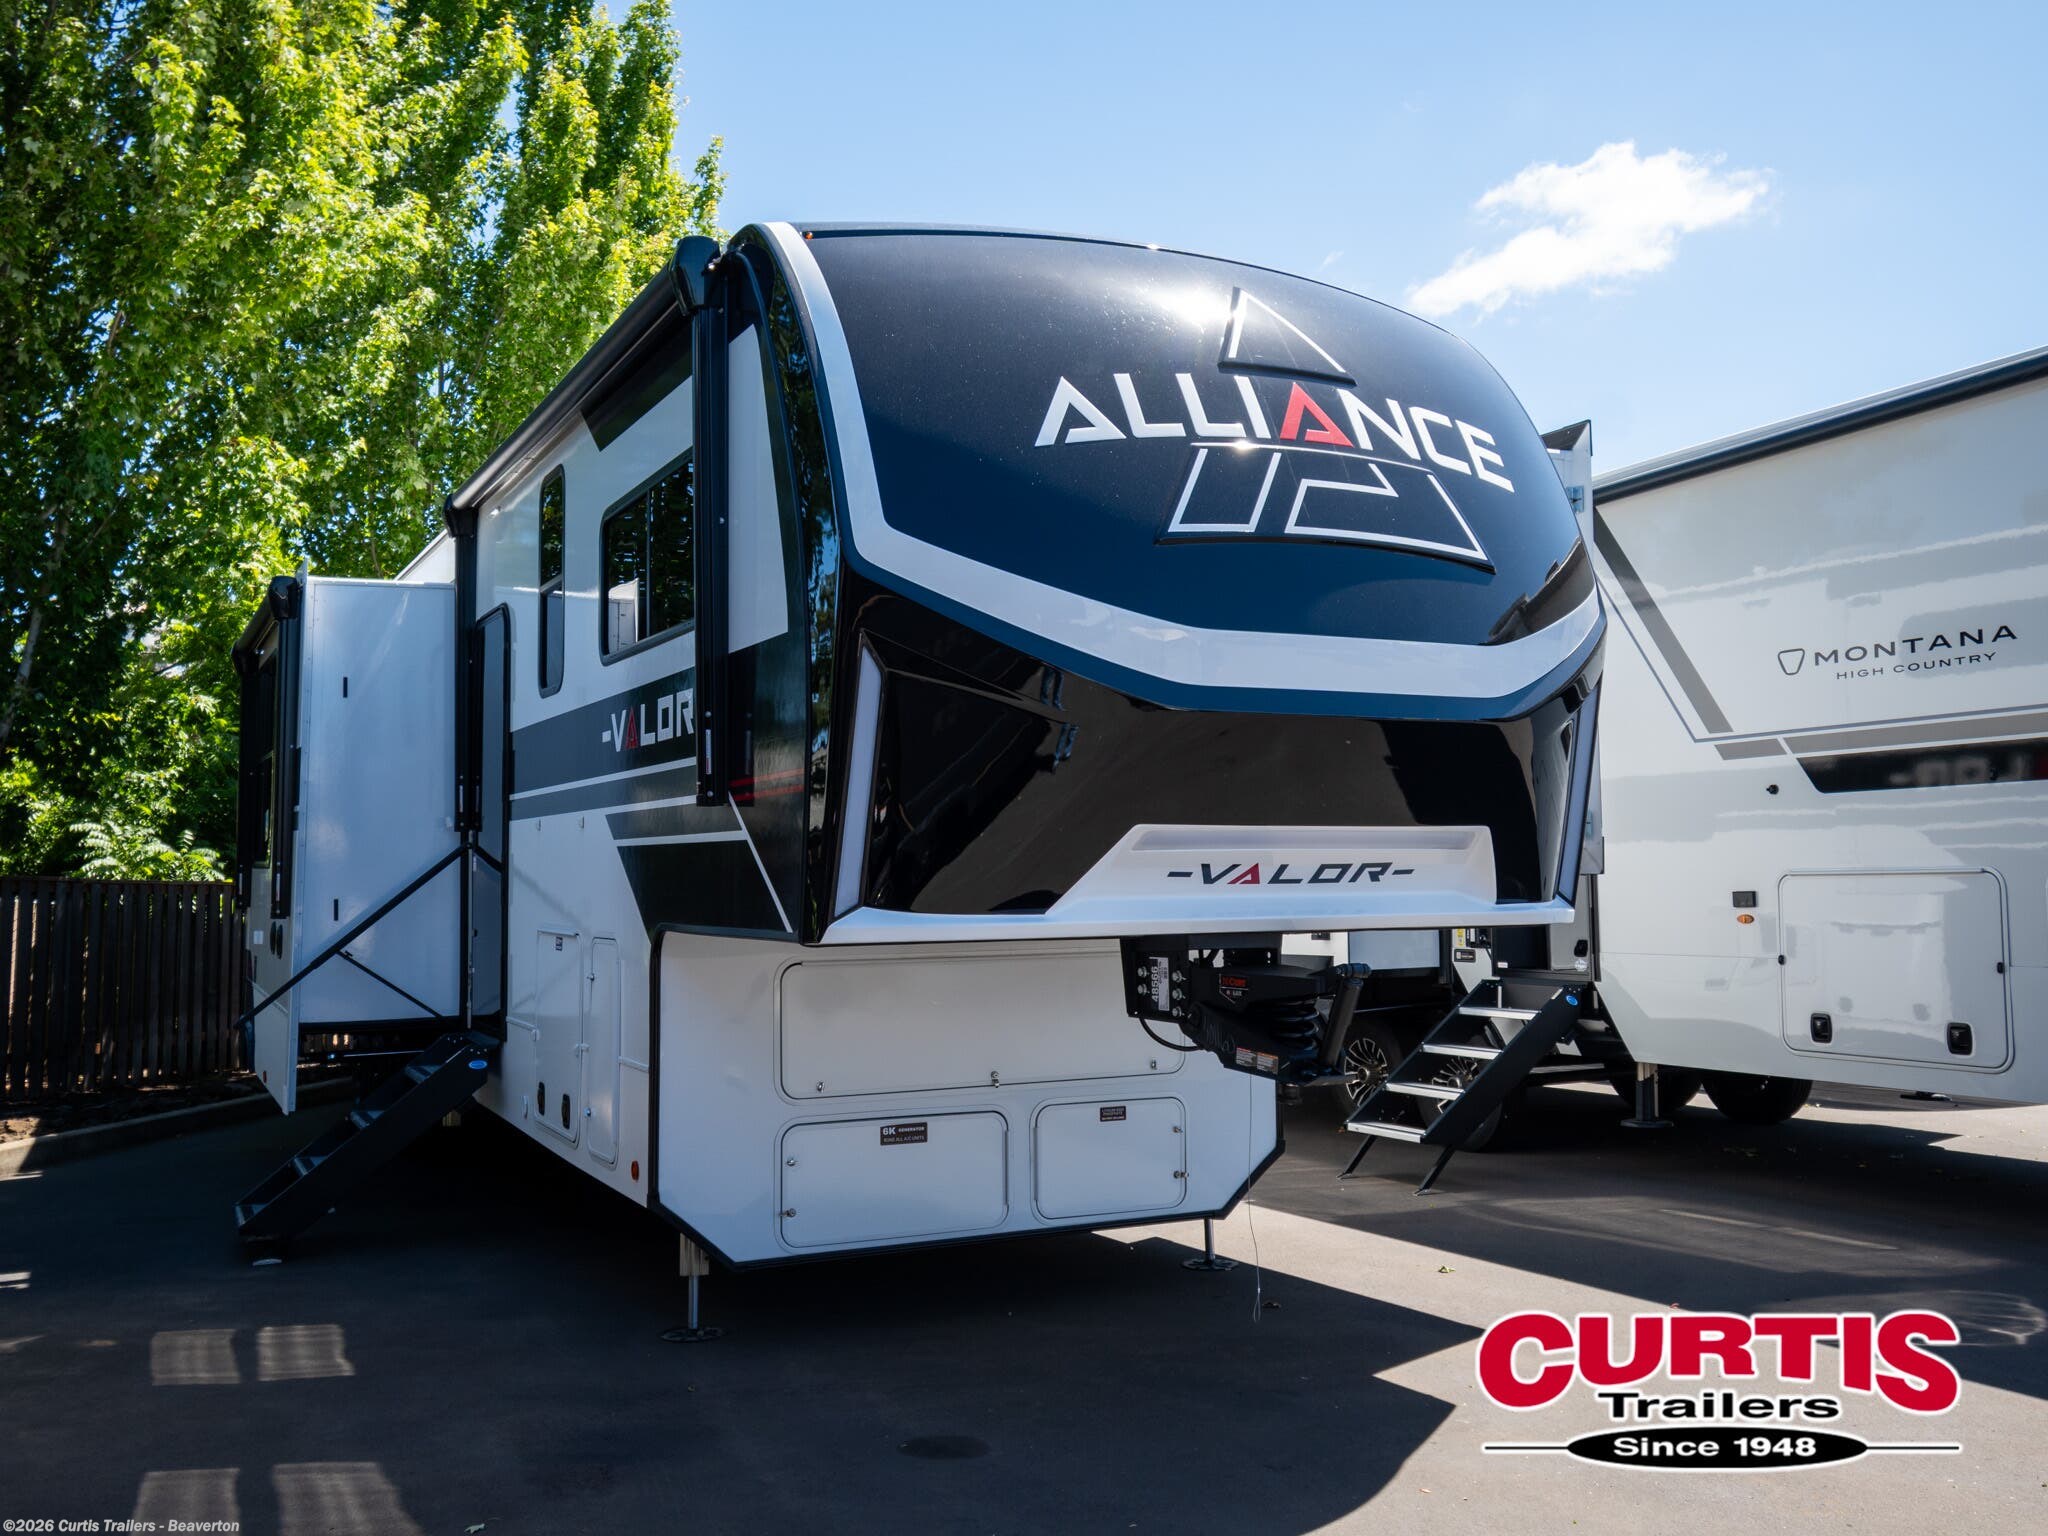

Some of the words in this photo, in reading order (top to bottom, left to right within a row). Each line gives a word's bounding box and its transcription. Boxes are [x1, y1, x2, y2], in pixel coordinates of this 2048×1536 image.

[1035, 373, 1514, 492] ALLIANCE
[1814, 625, 2018, 666] MONTANA
[1836, 666, 1884, 680] HIGH
[1893, 652, 1997, 673] COUNTRY
[1151, 966, 1159, 1003] 48566
[882, 1127, 896, 1136] 6K
